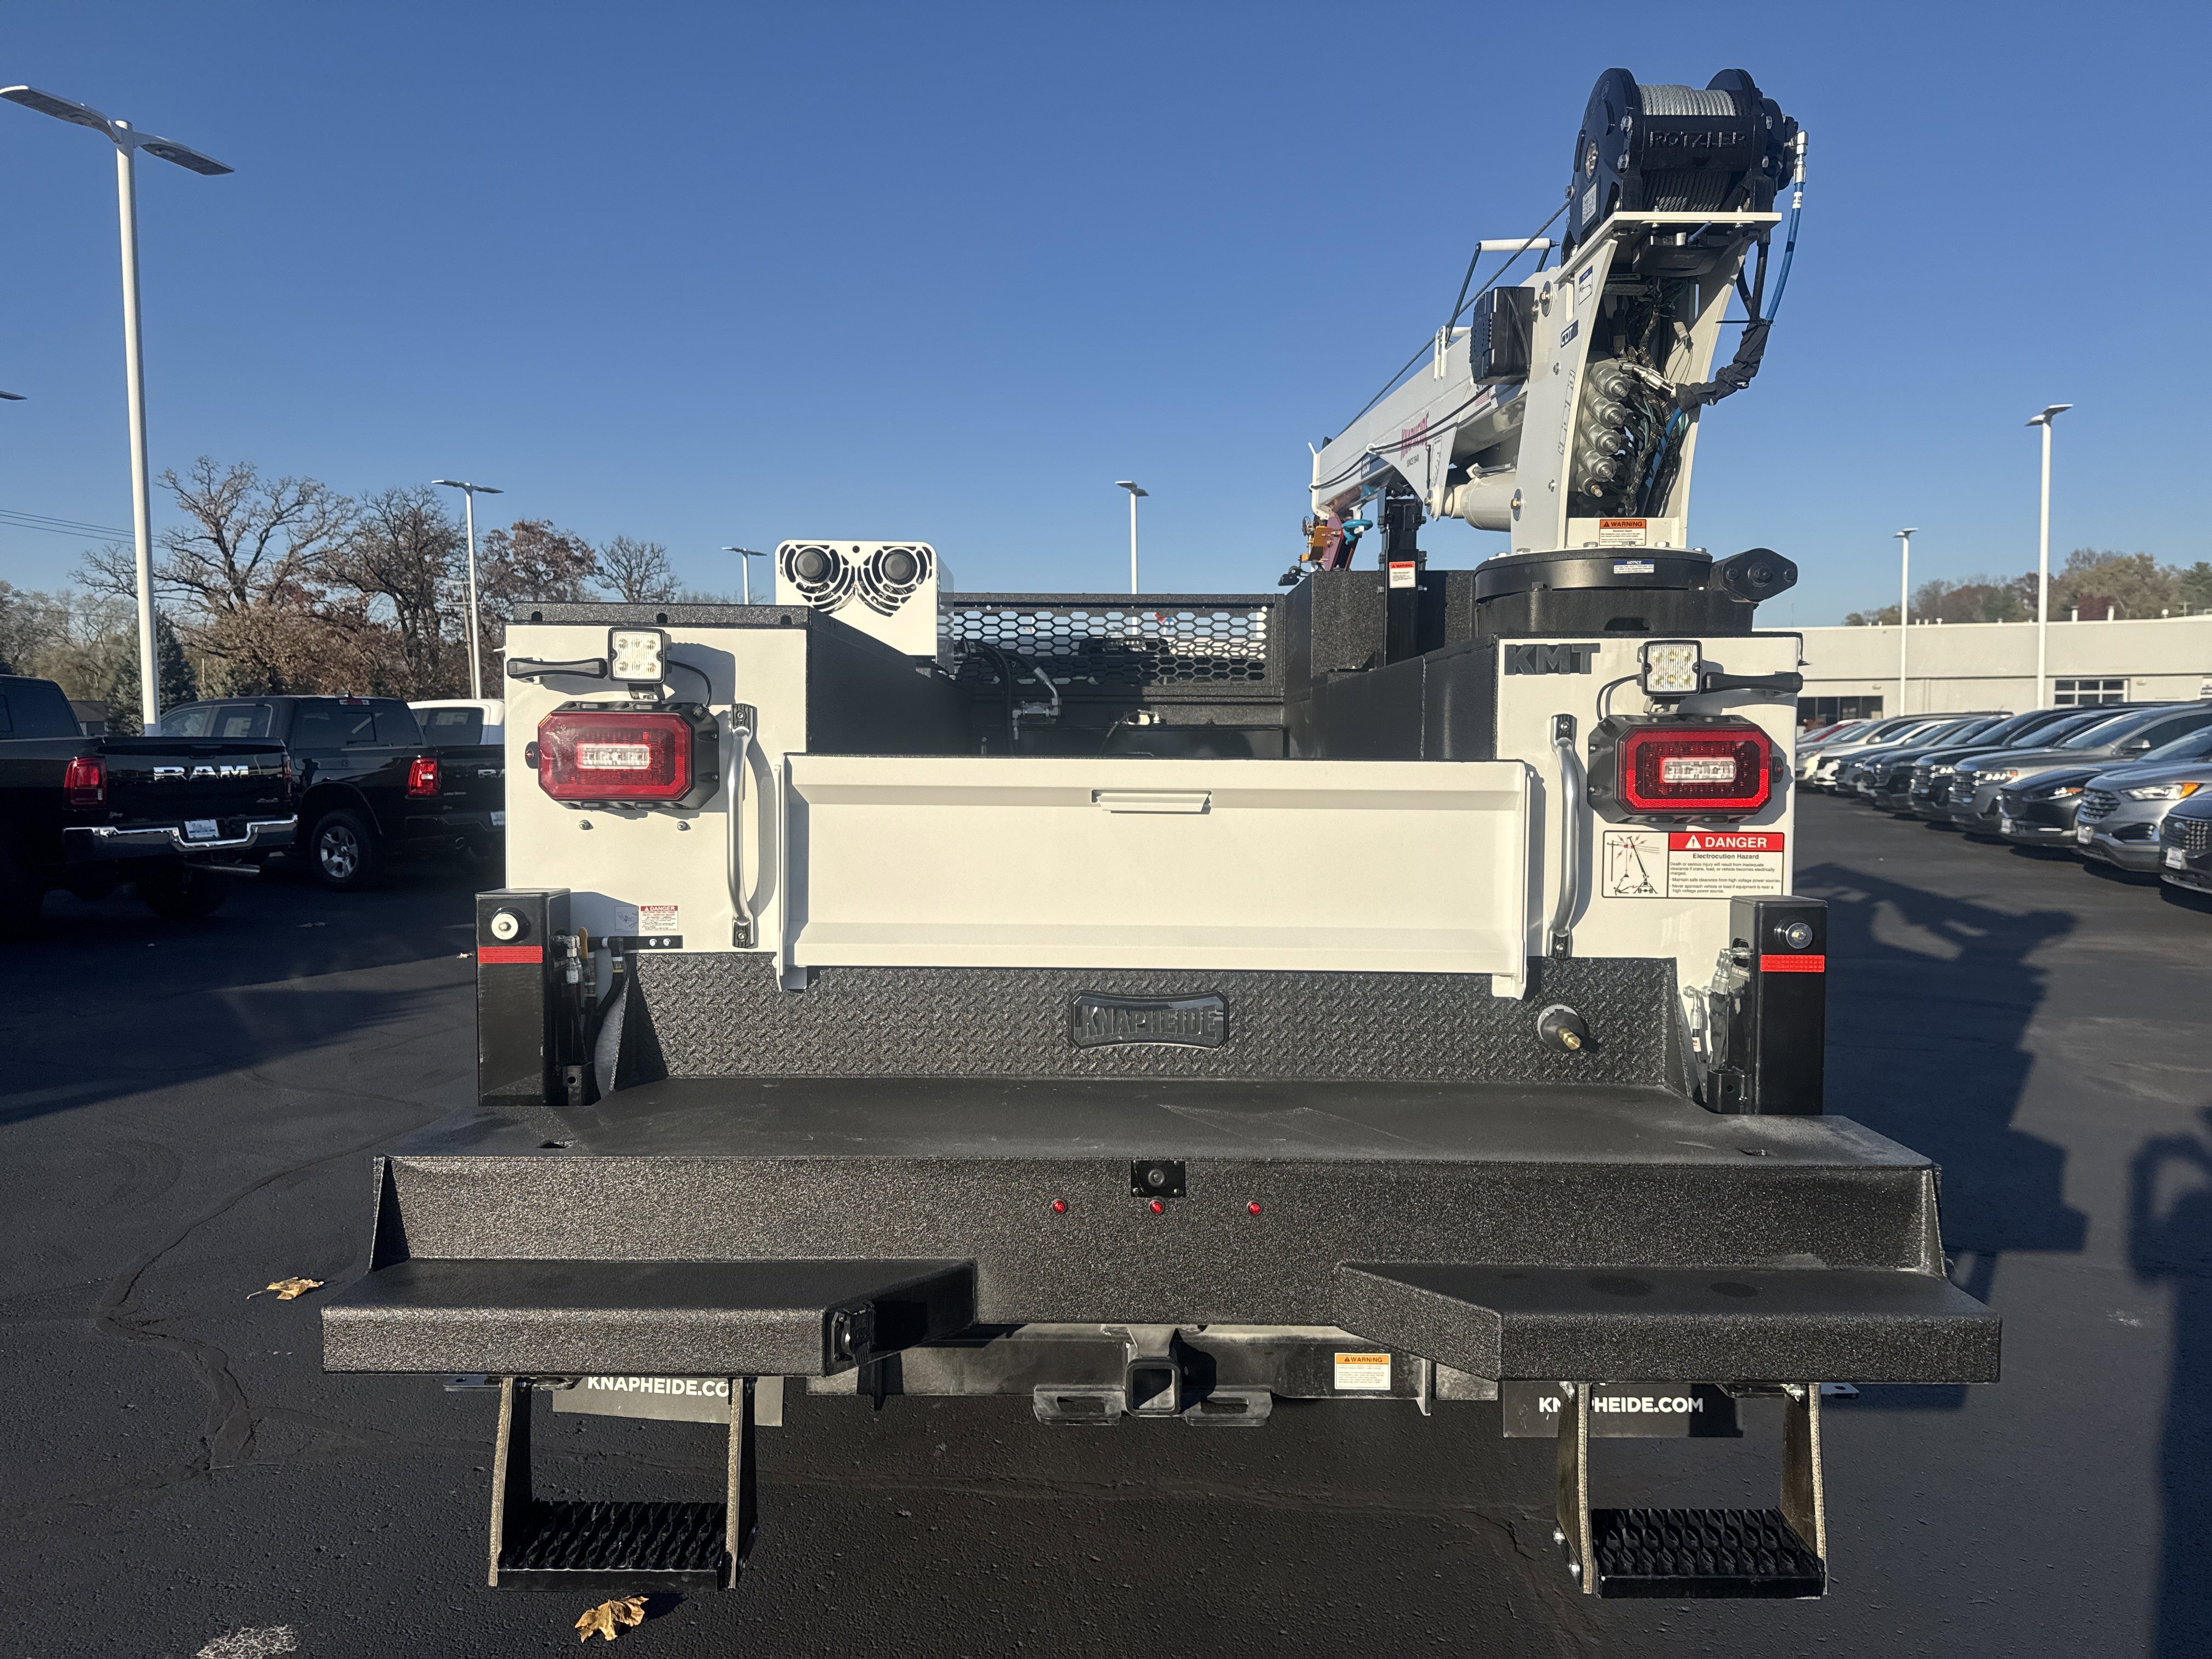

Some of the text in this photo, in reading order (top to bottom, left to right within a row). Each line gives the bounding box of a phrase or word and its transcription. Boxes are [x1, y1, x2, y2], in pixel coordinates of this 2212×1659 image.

[1650, 131, 1747, 148] ROTZLER
[1504, 643, 1601, 675] KMT
[154, 765, 249, 781] RAM
[1705, 837, 1767, 848] DANGER
[1081, 1004, 1217, 1039] KNAPHEIDE
[588, 1376, 729, 1397] KNAPHEIDE.CO
[1539, 1397, 1704, 1413] KNHEIDE.COM
